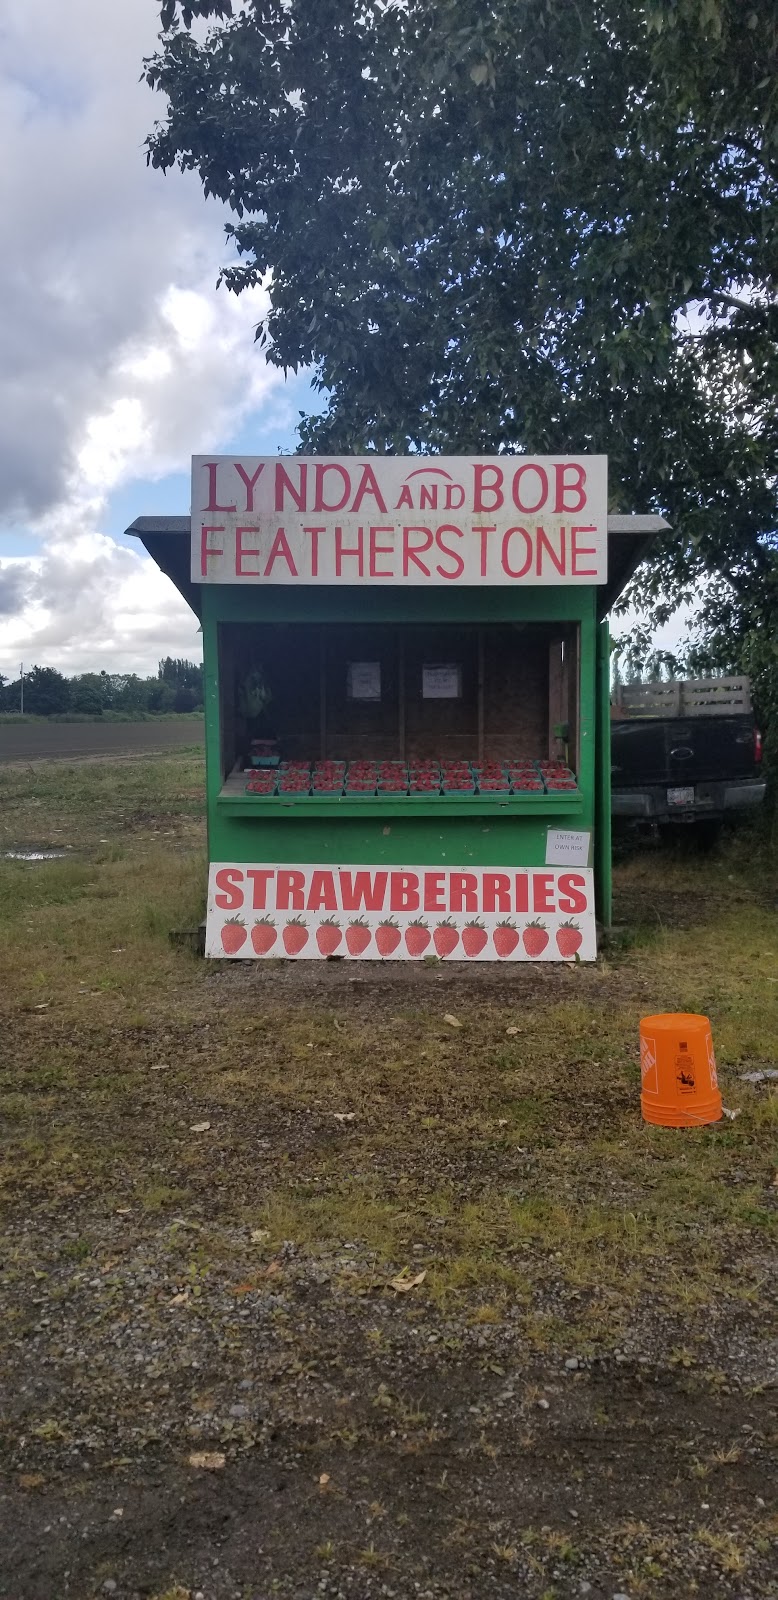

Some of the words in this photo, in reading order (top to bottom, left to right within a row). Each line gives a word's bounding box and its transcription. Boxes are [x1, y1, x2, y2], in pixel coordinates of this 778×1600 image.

[200, 463, 388, 513] LYNDA
[393, 484, 465, 510] AND
[472, 463, 587, 513] BOB
[201, 525, 598, 579] FEATHERSTONE
[215, 868, 588, 914] STRAWBERRIES
